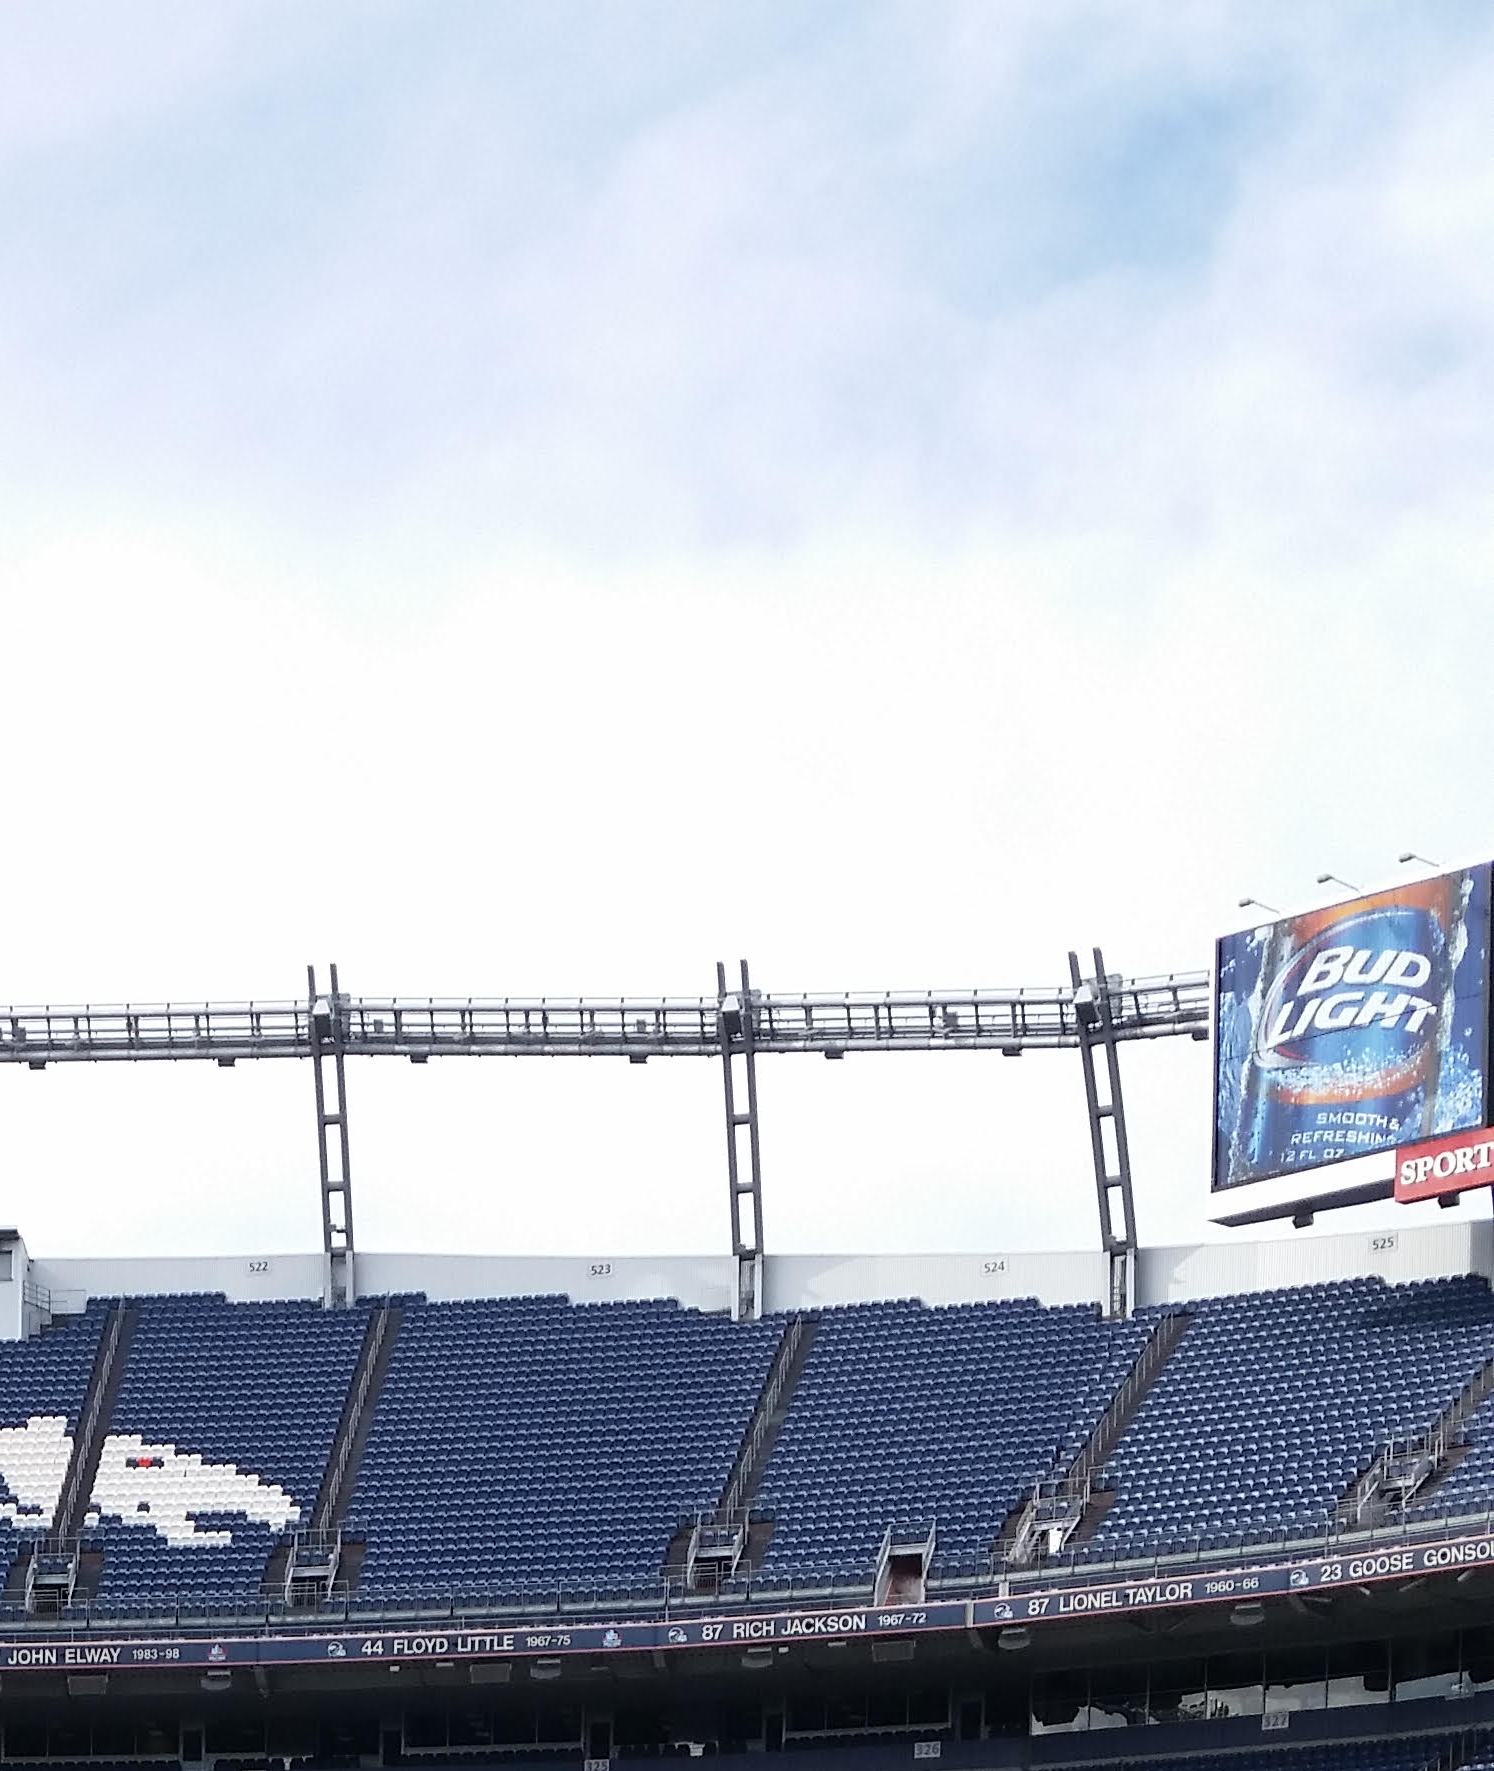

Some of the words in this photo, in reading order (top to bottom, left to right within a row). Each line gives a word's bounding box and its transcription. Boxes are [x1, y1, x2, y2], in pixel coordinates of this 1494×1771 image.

[1297, 945, 1432, 997] BUD
[1267, 991, 1438, 1045] LIGHT
[1316, 1112, 1387, 1129] SMOOTH
[1389, 1118, 1400, 1131] &
[1291, 1130, 1397, 1145] REFRESHING
[1280, 1149, 1295, 1163] 12
[1299, 1149, 1316, 1161] FL
[1400, 1141, 1494, 1186] SPORT
[1372, 1236, 1394, 1250] 525
[249, 1261, 269, 1272] 522
[590, 1264, 611, 1276] 523
[983, 1260, 1006, 1274] 524
[1320, 1563, 1342, 1582] 23
[1349, 1552, 1414, 1578] GOOSE
[1027, 1598, 1050, 1616] 87
[1058, 1588, 1123, 1613] LIONEL
[1124, 1582, 1193, 1605] TAYLOR
[1204, 1577, 1260, 1594] 1960-66
[701, 1623, 723, 1641] 87
[732, 1620, 775, 1639] RICH
[781, 1614, 866, 1635] JACKSON
[877, 1612, 927, 1627] 1967-72
[361, 1639, 383, 1655] 44
[393, 1637, 448, 1655] FLOYD
[457, 1635, 514, 1652] LITTLE
[525, 1635, 571, 1648] 1967-75
[8, 1649, 57, 1665] JOHN
[64, 1647, 121, 1664] ELWAY
[132, 1648, 180, 1660] 1983-98
